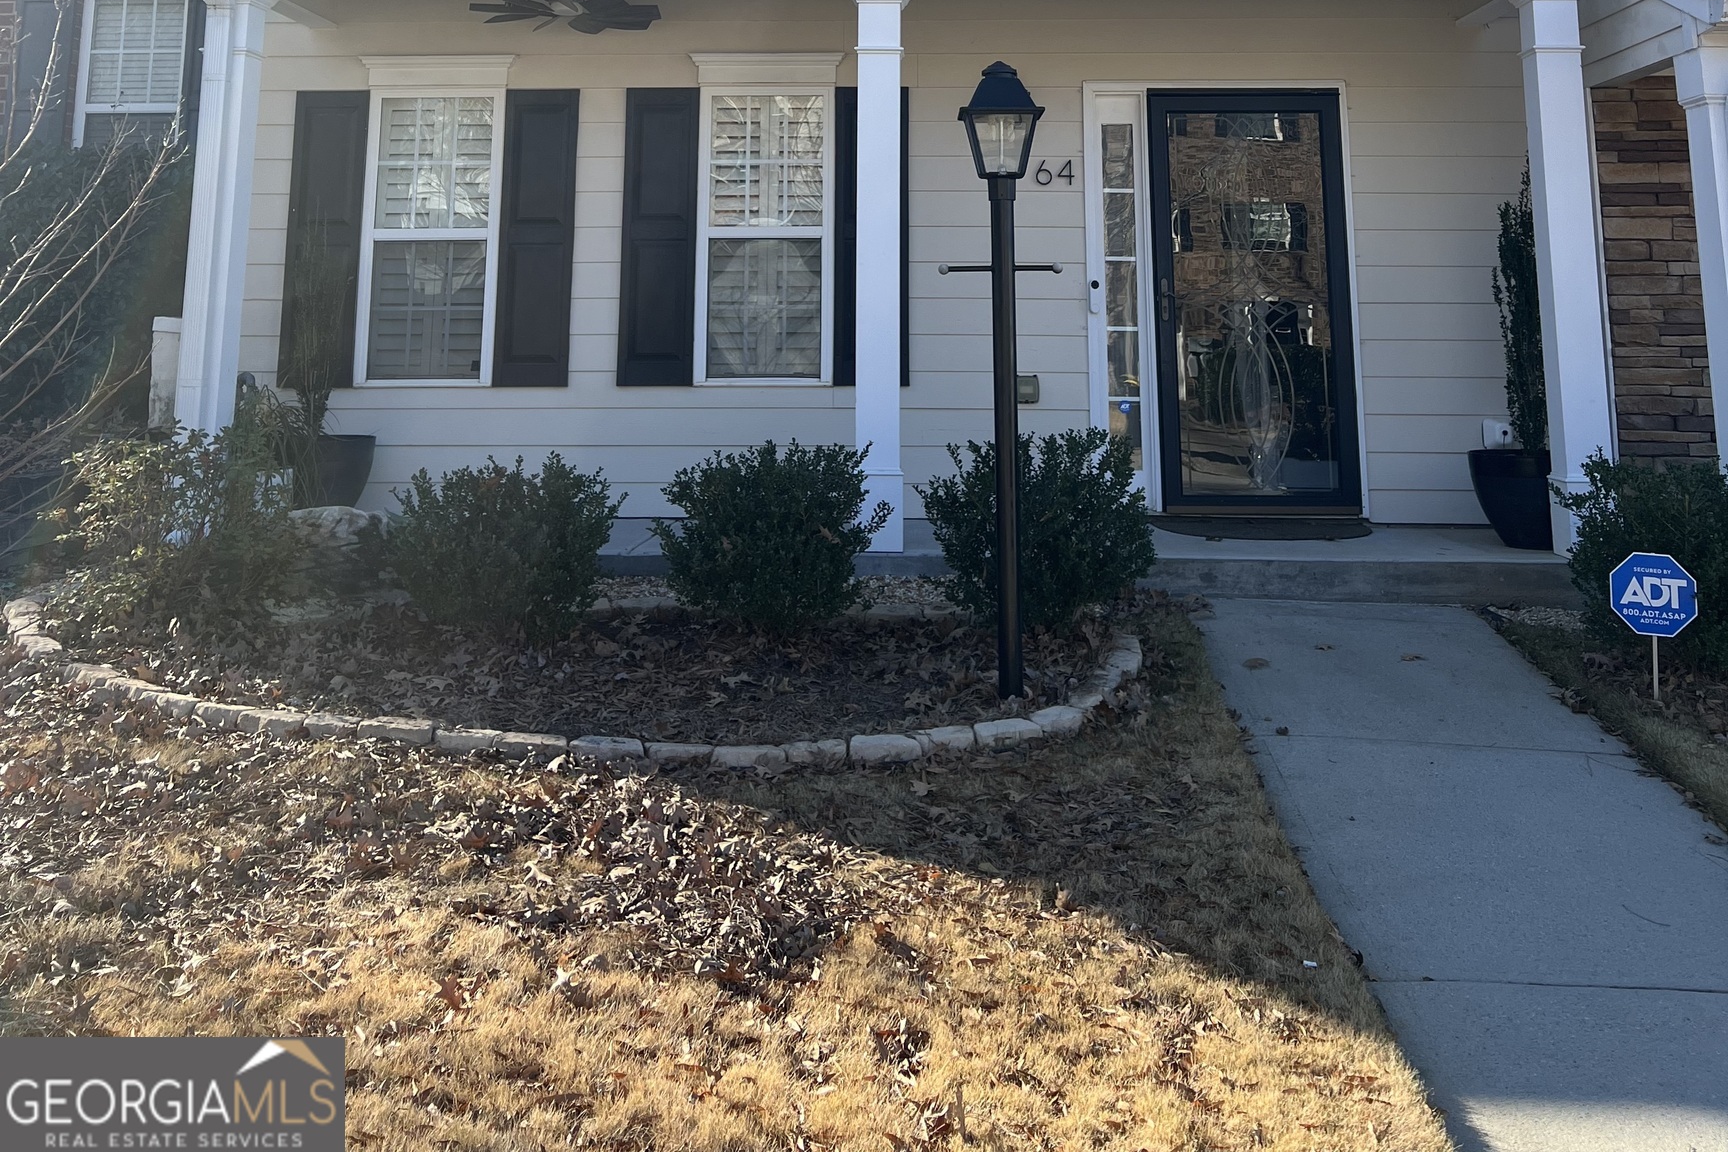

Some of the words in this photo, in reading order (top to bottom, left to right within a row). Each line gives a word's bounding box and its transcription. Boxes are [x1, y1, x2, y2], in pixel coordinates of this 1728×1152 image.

[1035, 159, 1075, 186] 64
[1633, 566, 1662, 574] SECURED
[1619, 575, 1688, 609] ADT
[1622, 608, 1686, 620] 800.ADT.ASAP
